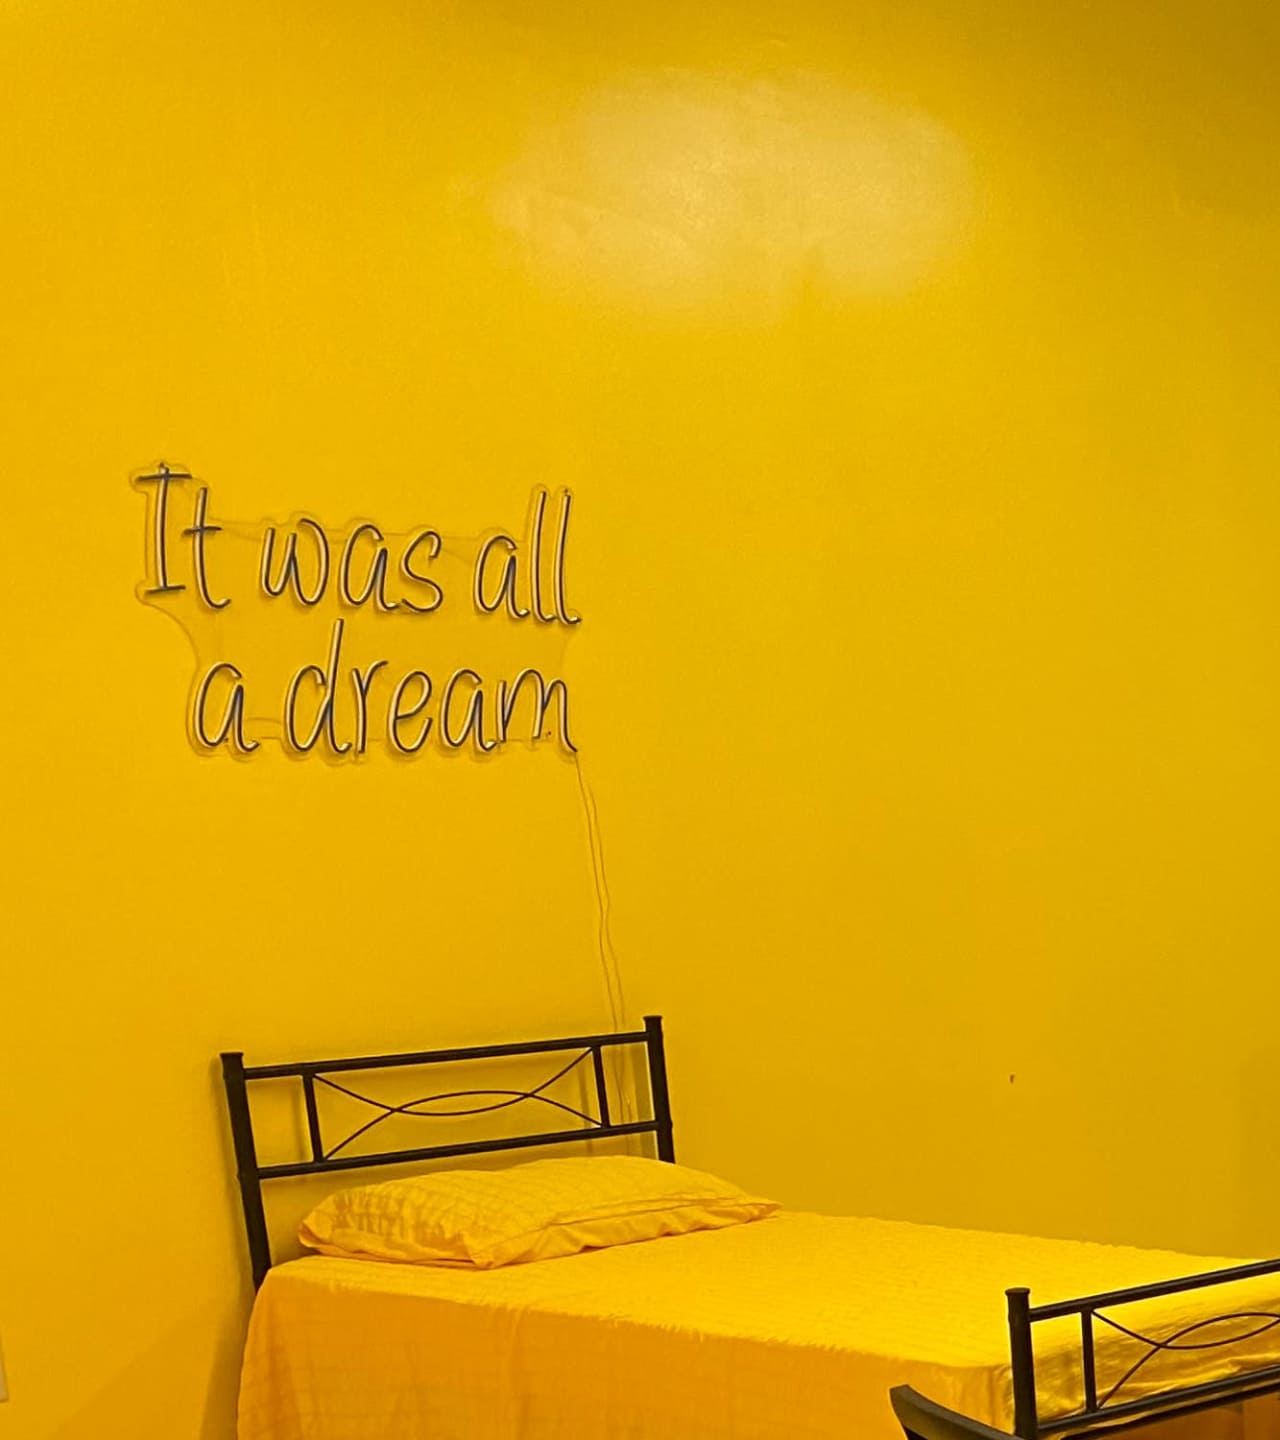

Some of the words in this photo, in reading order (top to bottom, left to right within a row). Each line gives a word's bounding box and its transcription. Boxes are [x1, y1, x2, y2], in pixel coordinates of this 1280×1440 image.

[131, 462, 231, 610] It
[259, 516, 444, 613] was
[472, 487, 582, 624] all
[193, 661, 260, 753] a
[283, 617, 578, 754] dream
